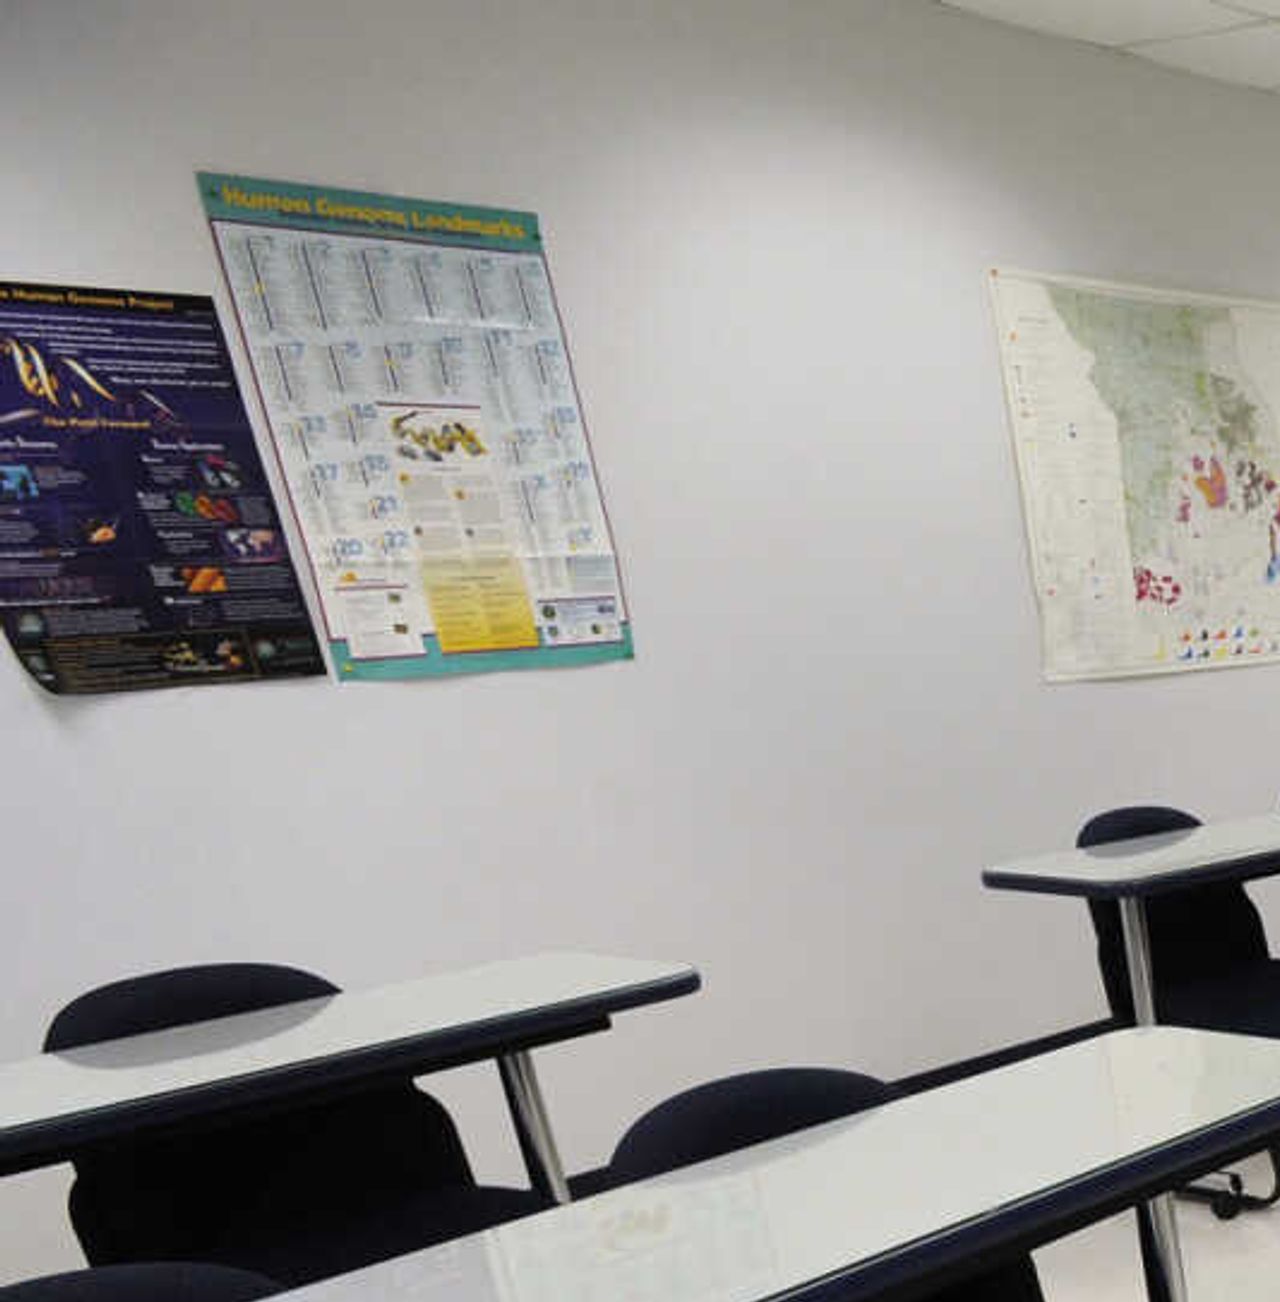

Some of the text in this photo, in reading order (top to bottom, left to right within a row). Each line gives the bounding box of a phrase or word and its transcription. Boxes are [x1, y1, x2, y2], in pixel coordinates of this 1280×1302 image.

[220, 183, 526, 238] Human Genome Landmarks
